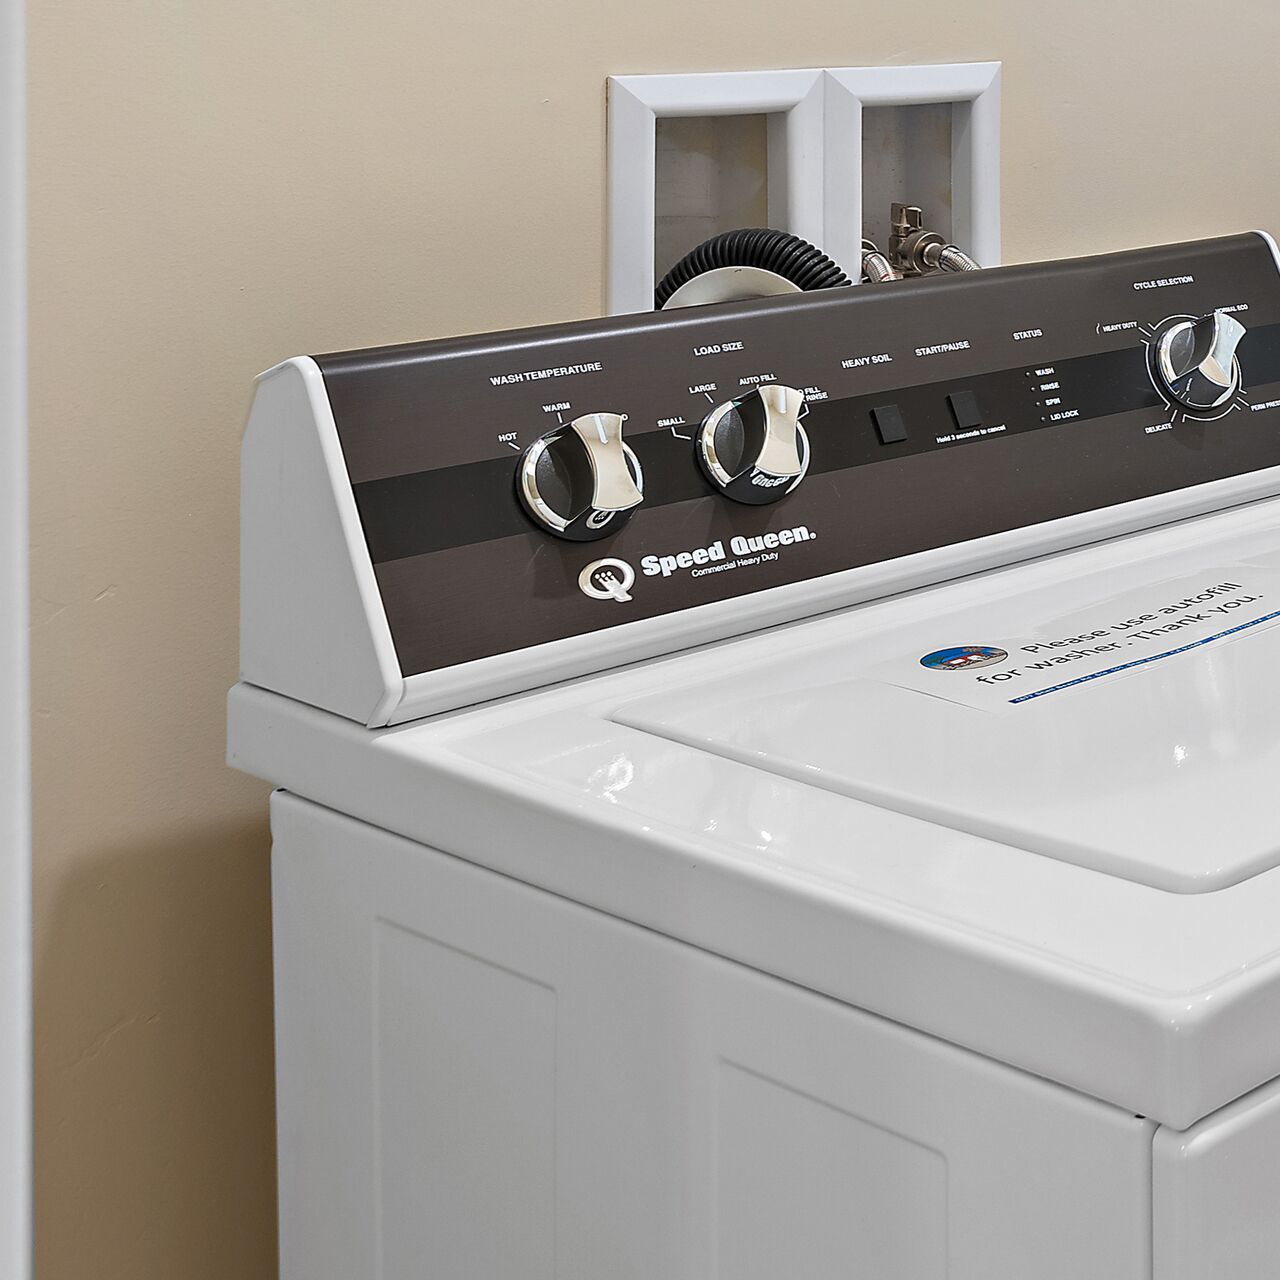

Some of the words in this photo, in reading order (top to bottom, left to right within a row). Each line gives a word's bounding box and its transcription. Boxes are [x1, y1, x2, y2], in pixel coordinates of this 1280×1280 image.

[1133, 279, 1156, 291] CYCLE
[1157, 275, 1194, 287] SELECTION
[1013, 328, 1043, 340] STATUS
[693, 344, 721, 356] LOAD
[722, 341, 744, 353] SIZE
[915, 340, 971, 357] START/PAUSE
[841, 356, 870, 369] HEAVY
[871, 353, 892, 365] SOIL
[489, 372, 524, 386] WASH
[523, 362, 603, 382] TEMPERATURE
[1034, 367, 1055, 377] WASH
[739, 375, 760, 386] AUTO
[760, 373, 777, 383] FILL
[688, 383, 717, 394] LARGE
[804, 386, 821, 394] FILL
[1040, 382, 1060, 391] RINSE
[543, 402, 571, 413] WARM
[1045, 397, 1061, 406] SPIN
[1062, 409, 1079, 420] LOCK
[657, 417, 685, 428] SMALL
[1145, 422, 1173, 434] DELICATE
[498, 432, 517, 442] HOT
[936, 435, 950, 444] Hold
[956, 429, 980, 440] seconds
[987, 424, 1006, 435] cancel
[640, 540, 726, 577] Speed
[691, 562, 736, 578] Commercial
[737, 555, 760, 569] Heavy
[761, 551, 779, 563] Duty
[1020, 629, 1110, 654] Please
[1110, 613, 1158, 631] use
[1158, 581, 1243, 614] autofill
[976, 669, 1022, 686] for
[1025, 641, 1133, 671] washer.
[1127, 612, 1213, 641] Thank
[1208, 593, 1264, 617] you.
